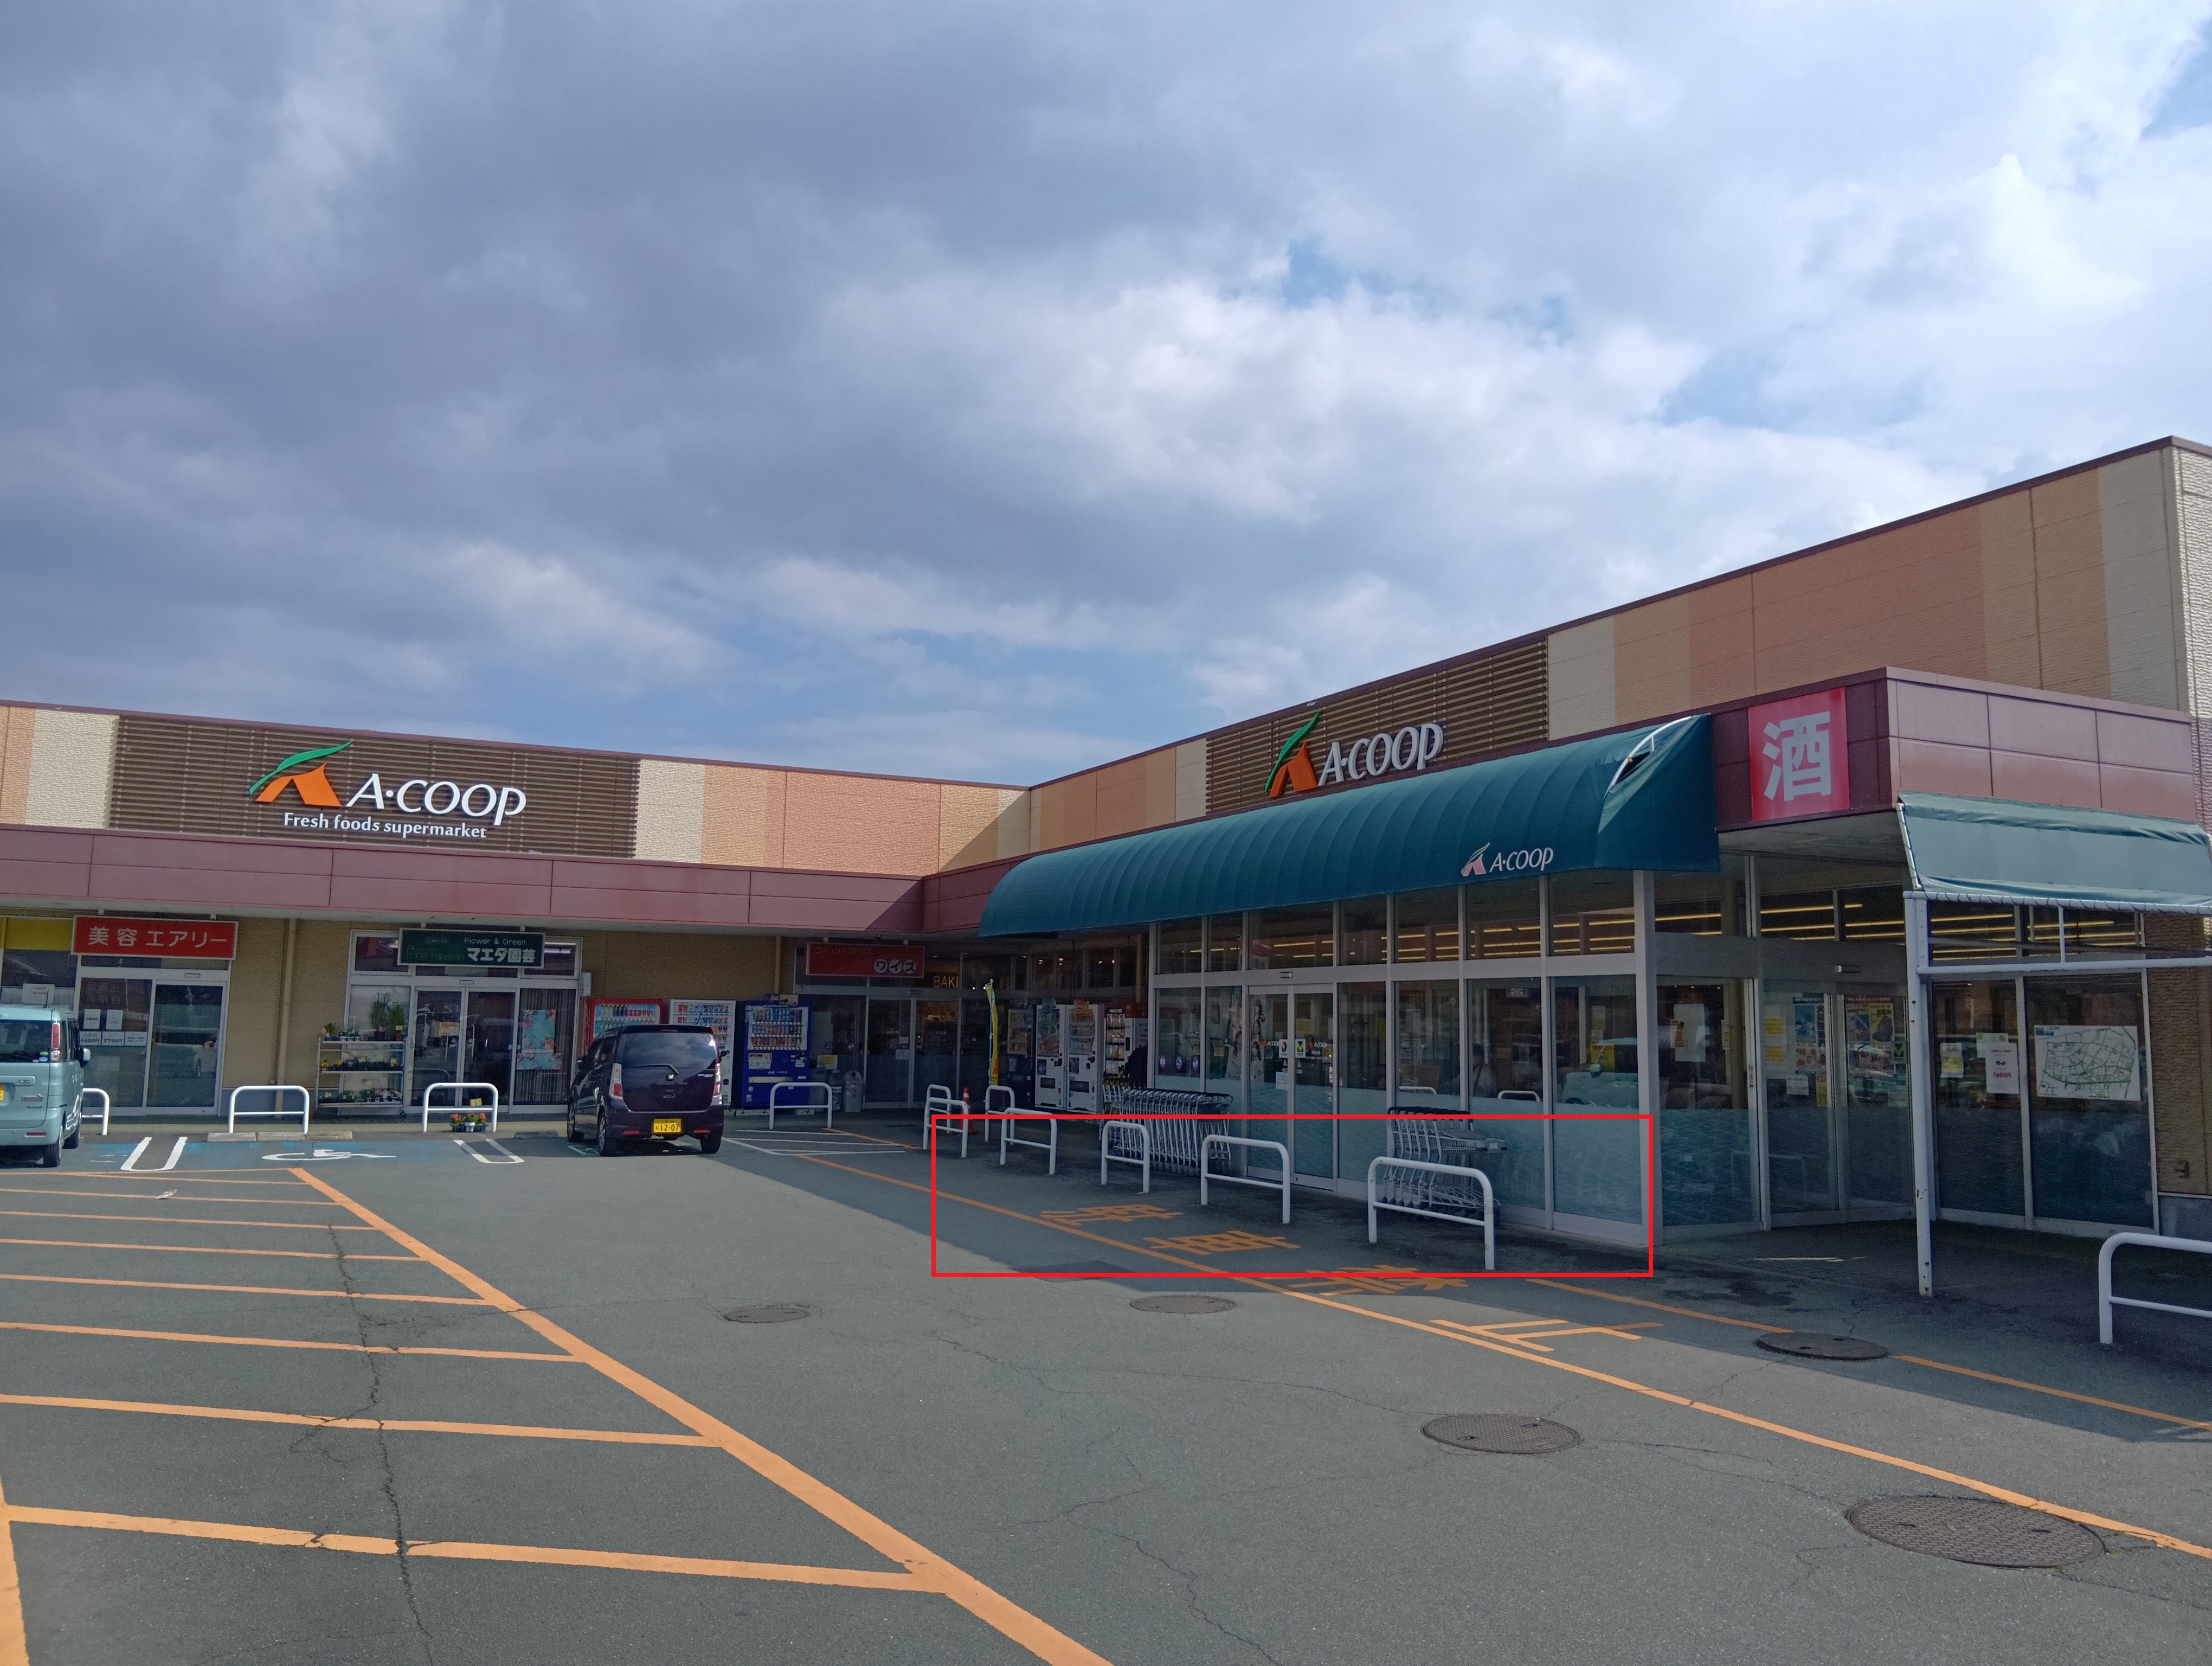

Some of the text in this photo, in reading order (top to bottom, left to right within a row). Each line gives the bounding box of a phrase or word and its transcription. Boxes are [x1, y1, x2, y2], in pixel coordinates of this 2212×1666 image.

[1763, 711, 1831, 801] 酒
[284, 812, 487, 838] Fresh foods supermarket
[88, 926, 228, 948] 美容 エアリー
[467, 947, 536, 963] マエダ園芸
[815, 946, 872, 955] ファッションハウス
